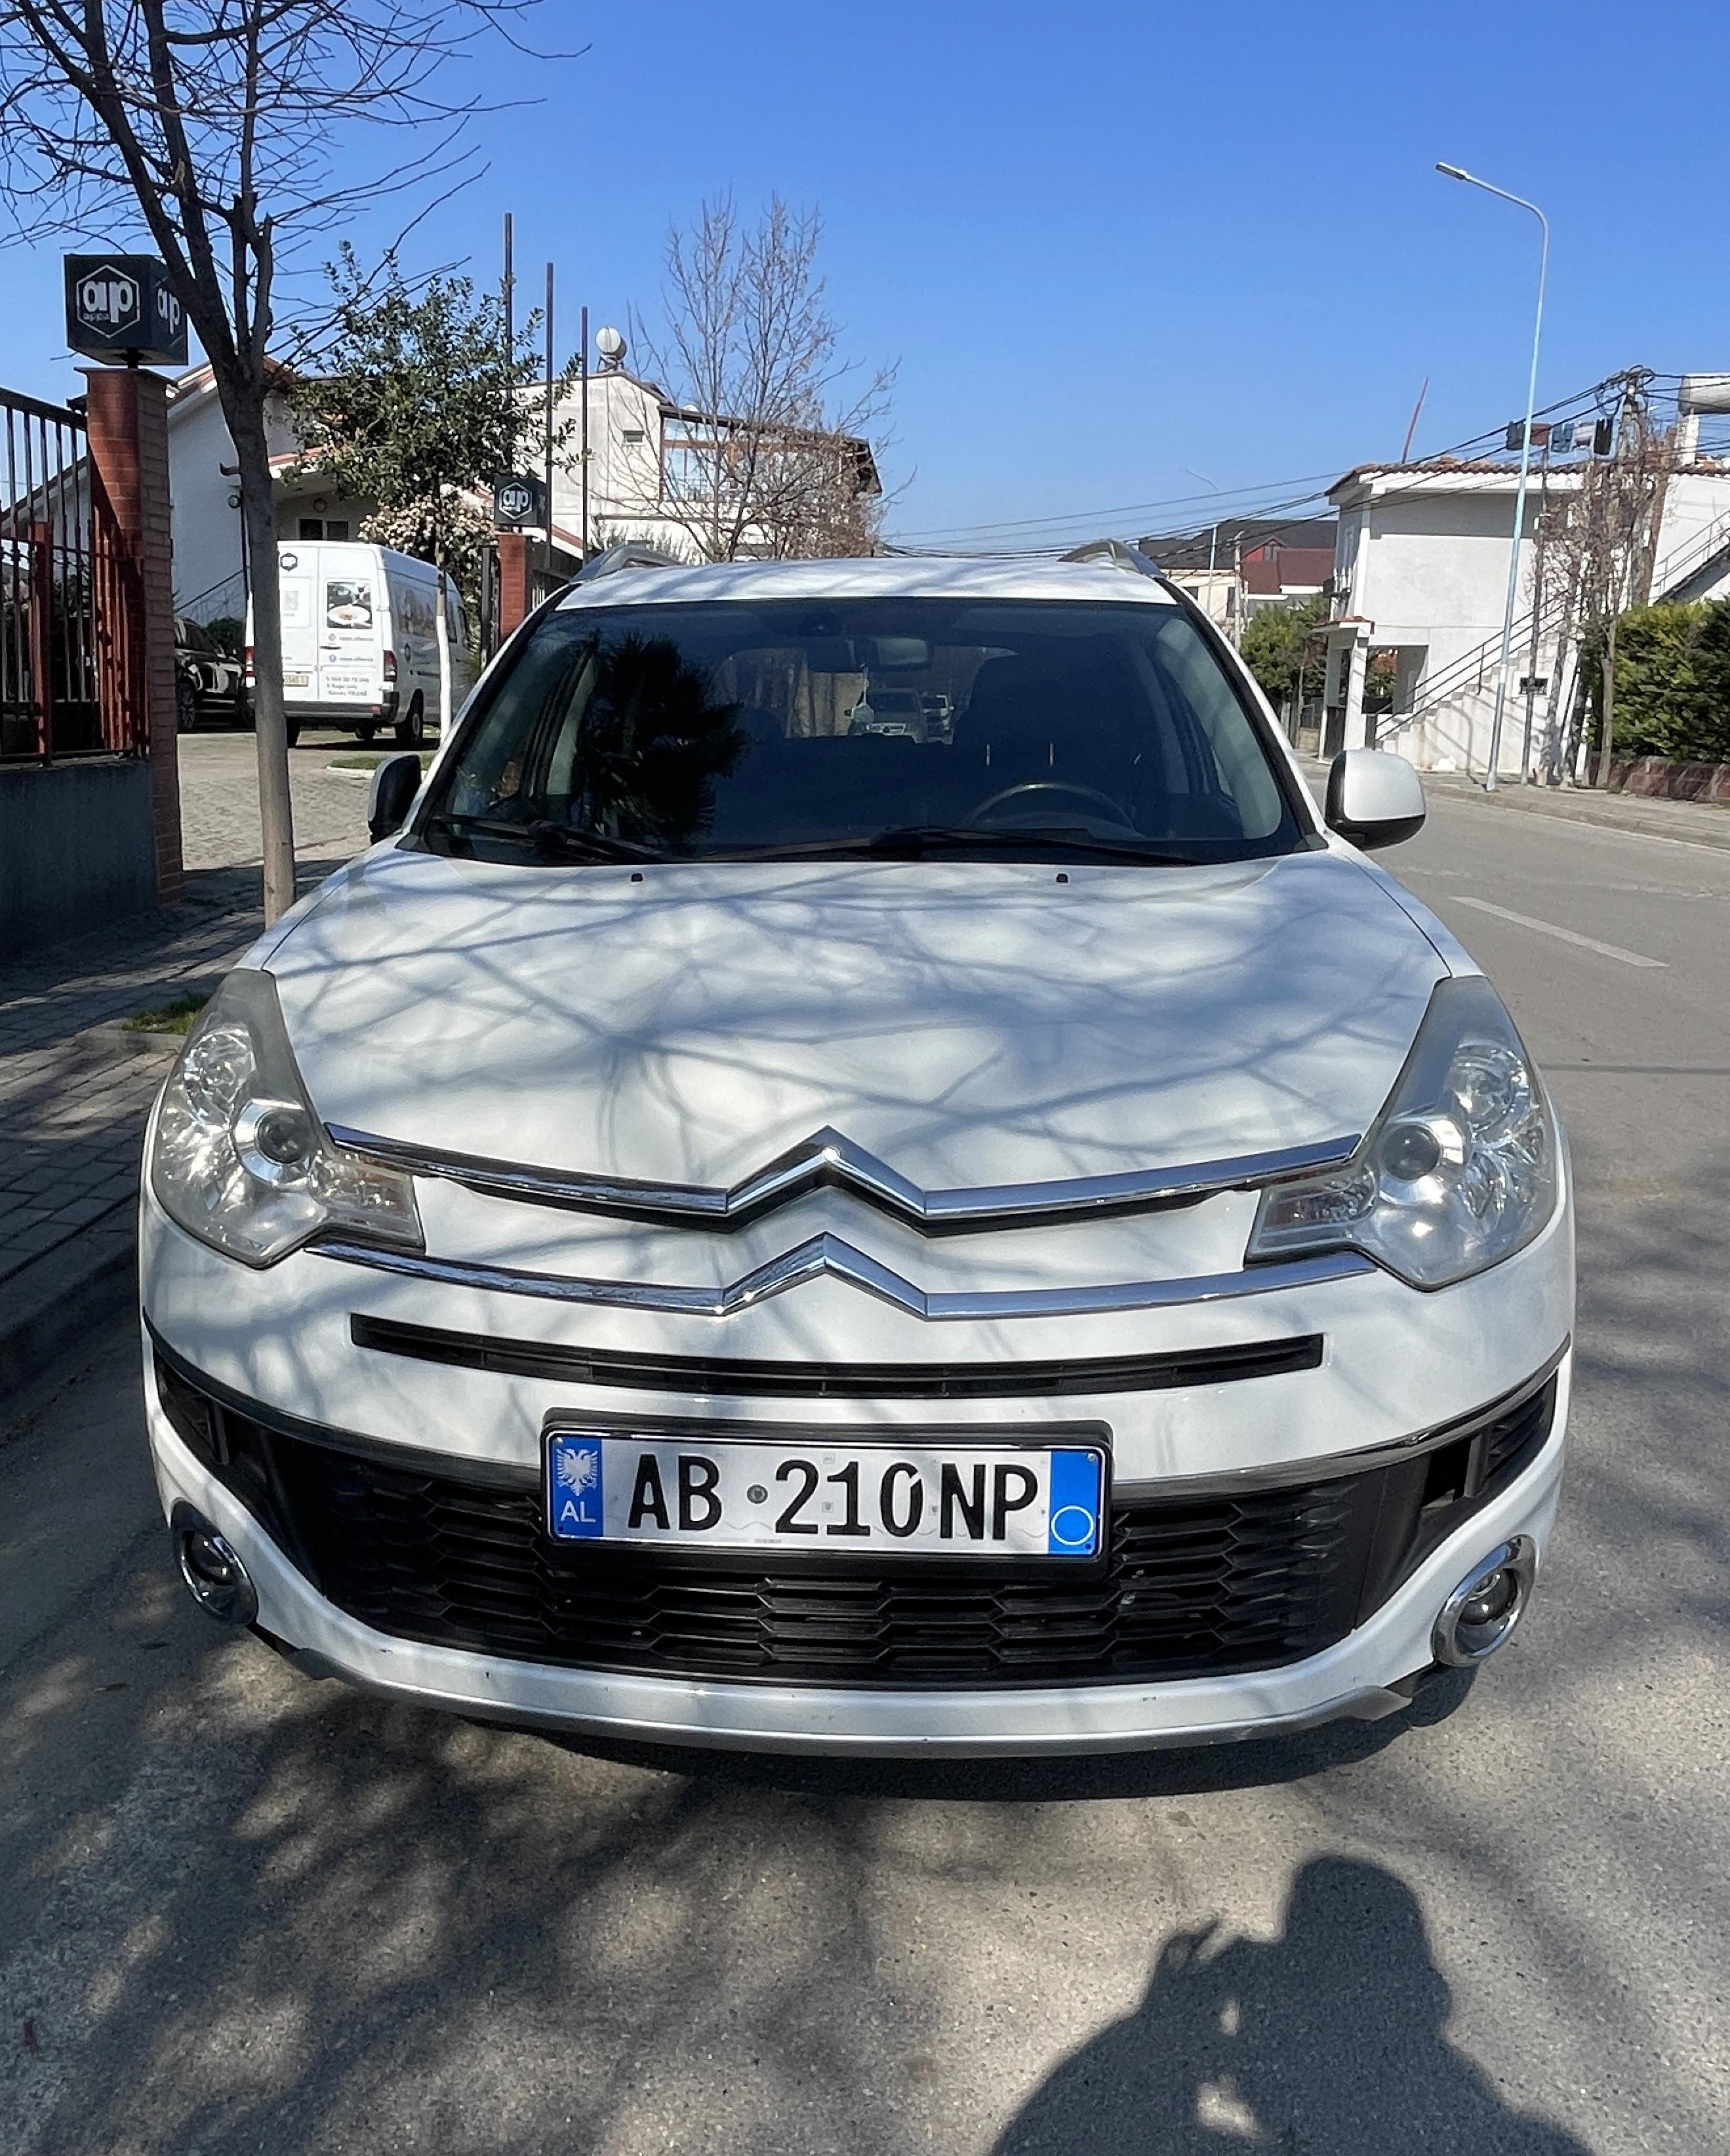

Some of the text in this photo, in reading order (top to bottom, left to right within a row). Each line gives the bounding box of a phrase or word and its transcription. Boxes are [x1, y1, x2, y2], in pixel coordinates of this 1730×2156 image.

[83, 281, 134, 323] ap
[157, 287, 180, 335] ap
[503, 490, 529, 512] ap
[560, 1500, 597, 1523] AL
[627, 1454, 723, 1531] AB
